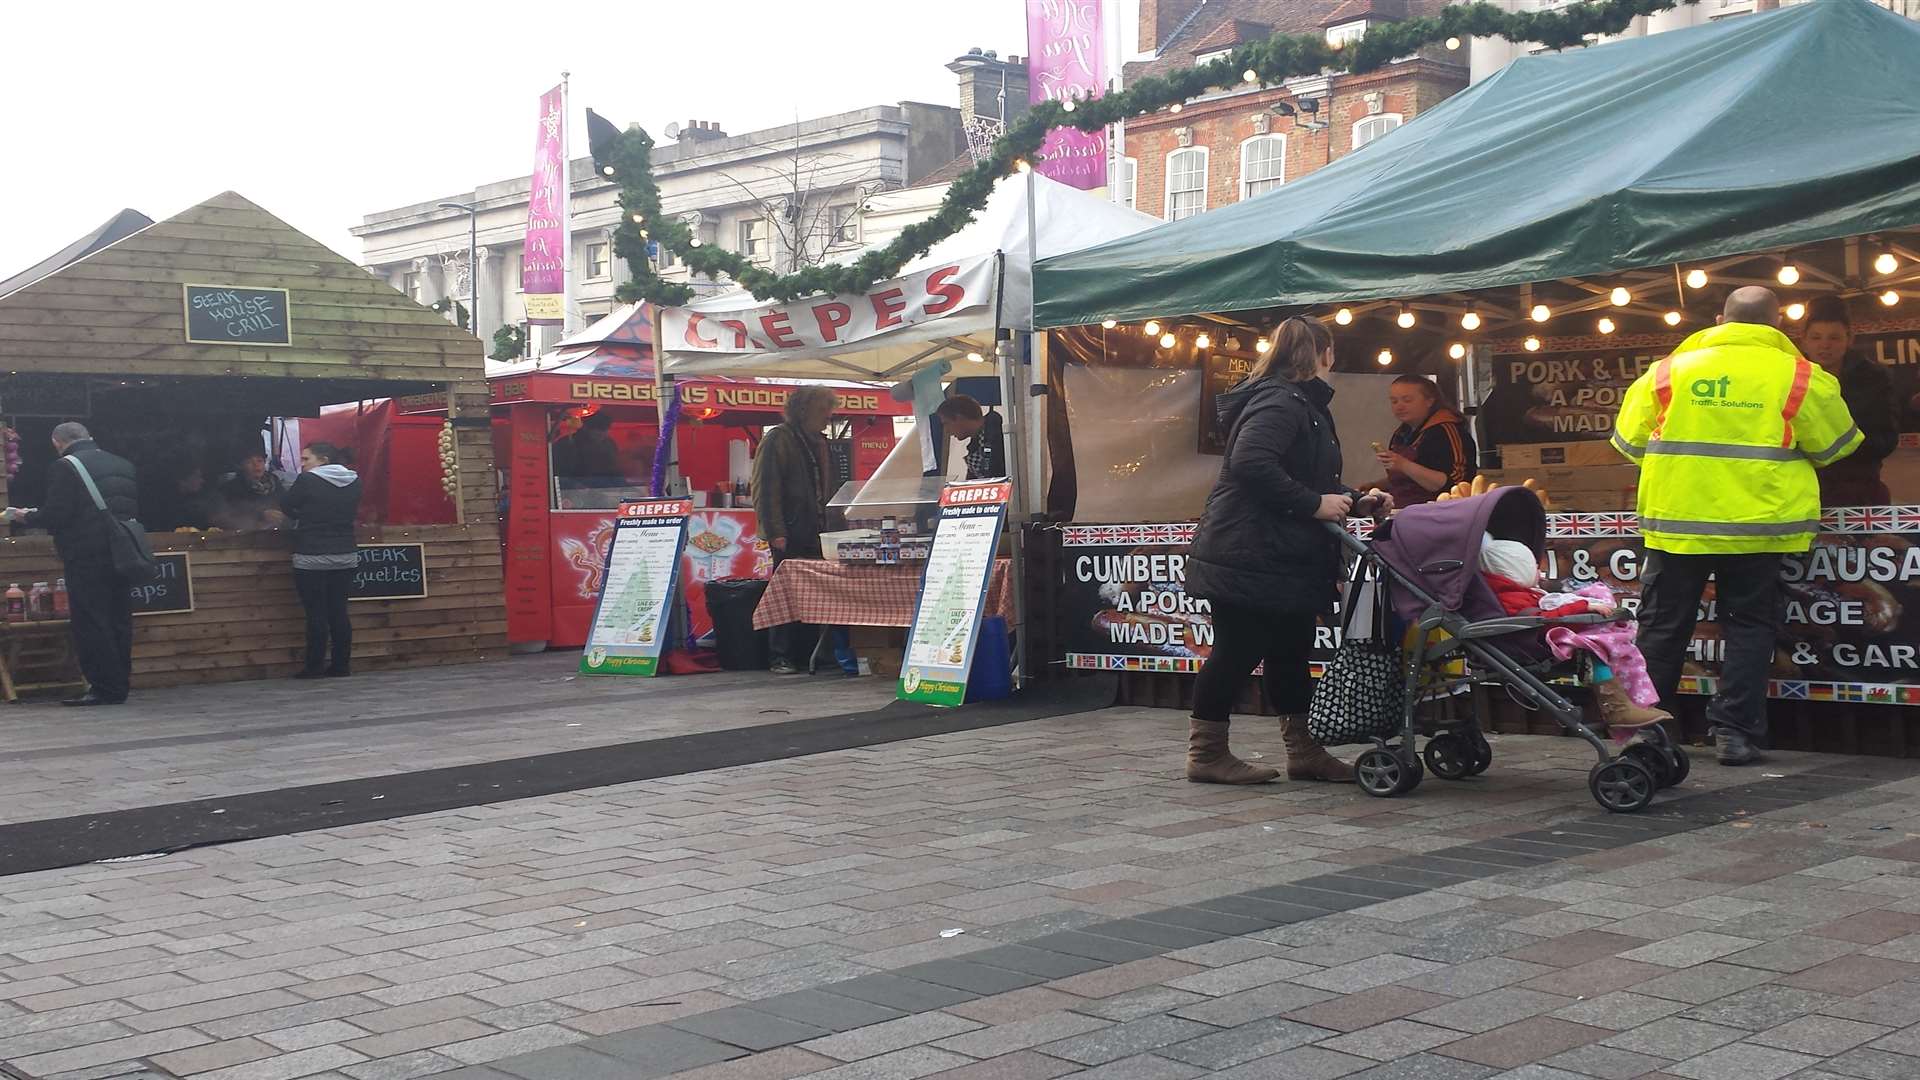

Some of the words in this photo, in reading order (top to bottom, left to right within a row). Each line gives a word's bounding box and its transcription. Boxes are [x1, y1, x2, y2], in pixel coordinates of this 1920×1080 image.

[209, 296, 275, 322] HOUSE
[227, 313, 280, 336] GRILL
[1229, 359, 1254, 372] MEN
[1510, 359, 1586, 384] PORK
[1593, 358, 1612, 380] &
[572, 380, 708, 403] DRAGS
[716, 388, 789, 406] NOOD
[1691, 376, 1730, 397] at
[1551, 389, 1567, 407] A
[1691, 399, 1718, 407] Traffic
[1720, 400, 1764, 408] Solutions
[1554, 413, 1616, 434] MAD
[950, 487, 998, 502] CREPES
[628, 503, 680, 516] CREPES
[942, 507, 961, 517] Freshly
[961, 506, 975, 514] made
[976, 505, 982, 513] to
[983, 504, 1000, 513] order
[620, 518, 642, 527] Freshly
[1075, 554, 1189, 583] CUMBER
[1572, 549, 1599, 580] &
[353, 565, 422, 588] guettes
[130, 584, 168, 604] aps
[1117, 591, 1134, 612] A
[1109, 622, 1185, 645] MADE
[1791, 641, 1818, 665] &
[1832, 643, 1920, 668] GAR
